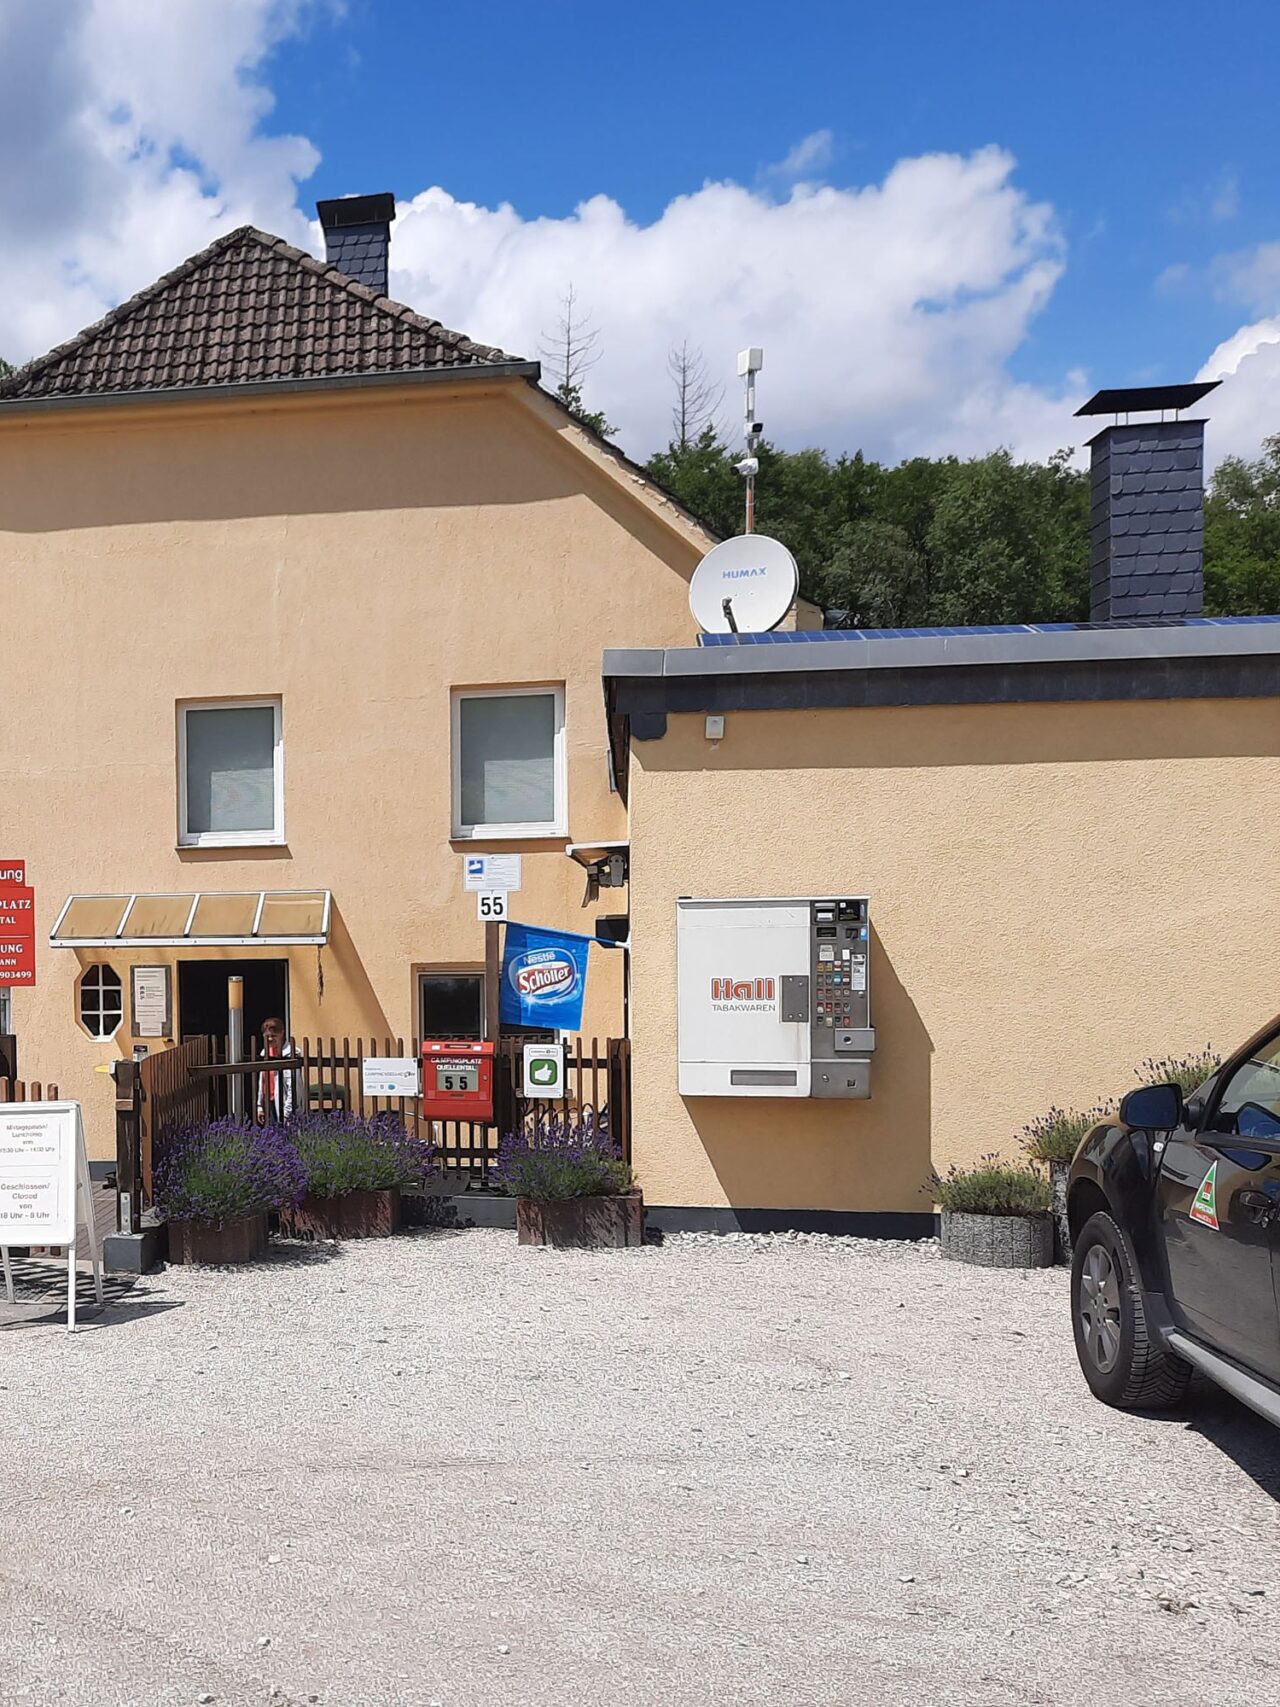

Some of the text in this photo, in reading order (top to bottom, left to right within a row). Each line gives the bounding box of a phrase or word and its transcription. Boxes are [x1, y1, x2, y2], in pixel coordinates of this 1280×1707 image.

[722, 567, 767, 579] HUMAX
[481, 897, 504, 916] 55
[519, 966, 570, 994] Schöller
[711, 977, 775, 1000] Hall
[711, 1004, 776, 1012] TABAKWAREN
